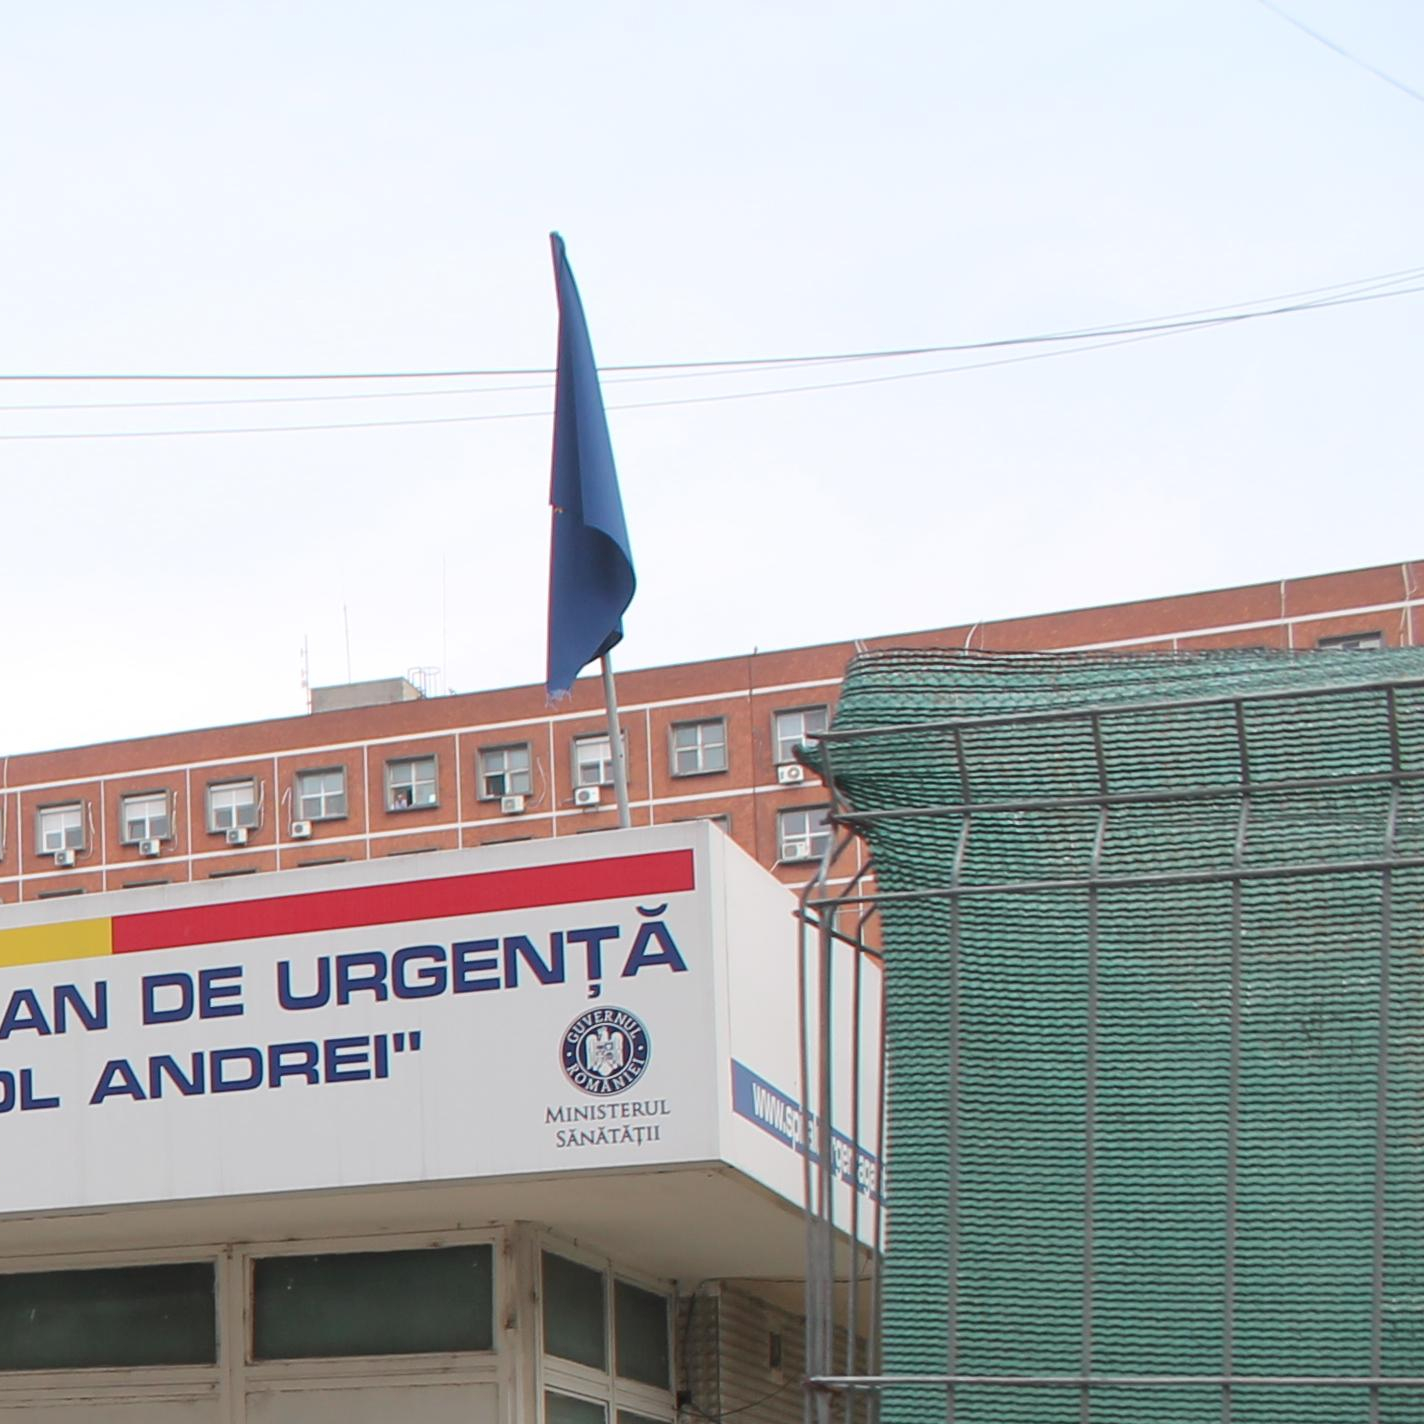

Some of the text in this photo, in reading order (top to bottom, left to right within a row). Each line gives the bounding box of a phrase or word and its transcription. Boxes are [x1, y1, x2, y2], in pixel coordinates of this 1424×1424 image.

[142, 965, 245, 1025] DE
[277, 903, 688, 1010] URGENȚĂ
[567, 1010, 641, 1044] GUVERNUL
[89, 1030, 423, 1105] ANDREI"
[545, 1100, 671, 1124] MINISTERUL
